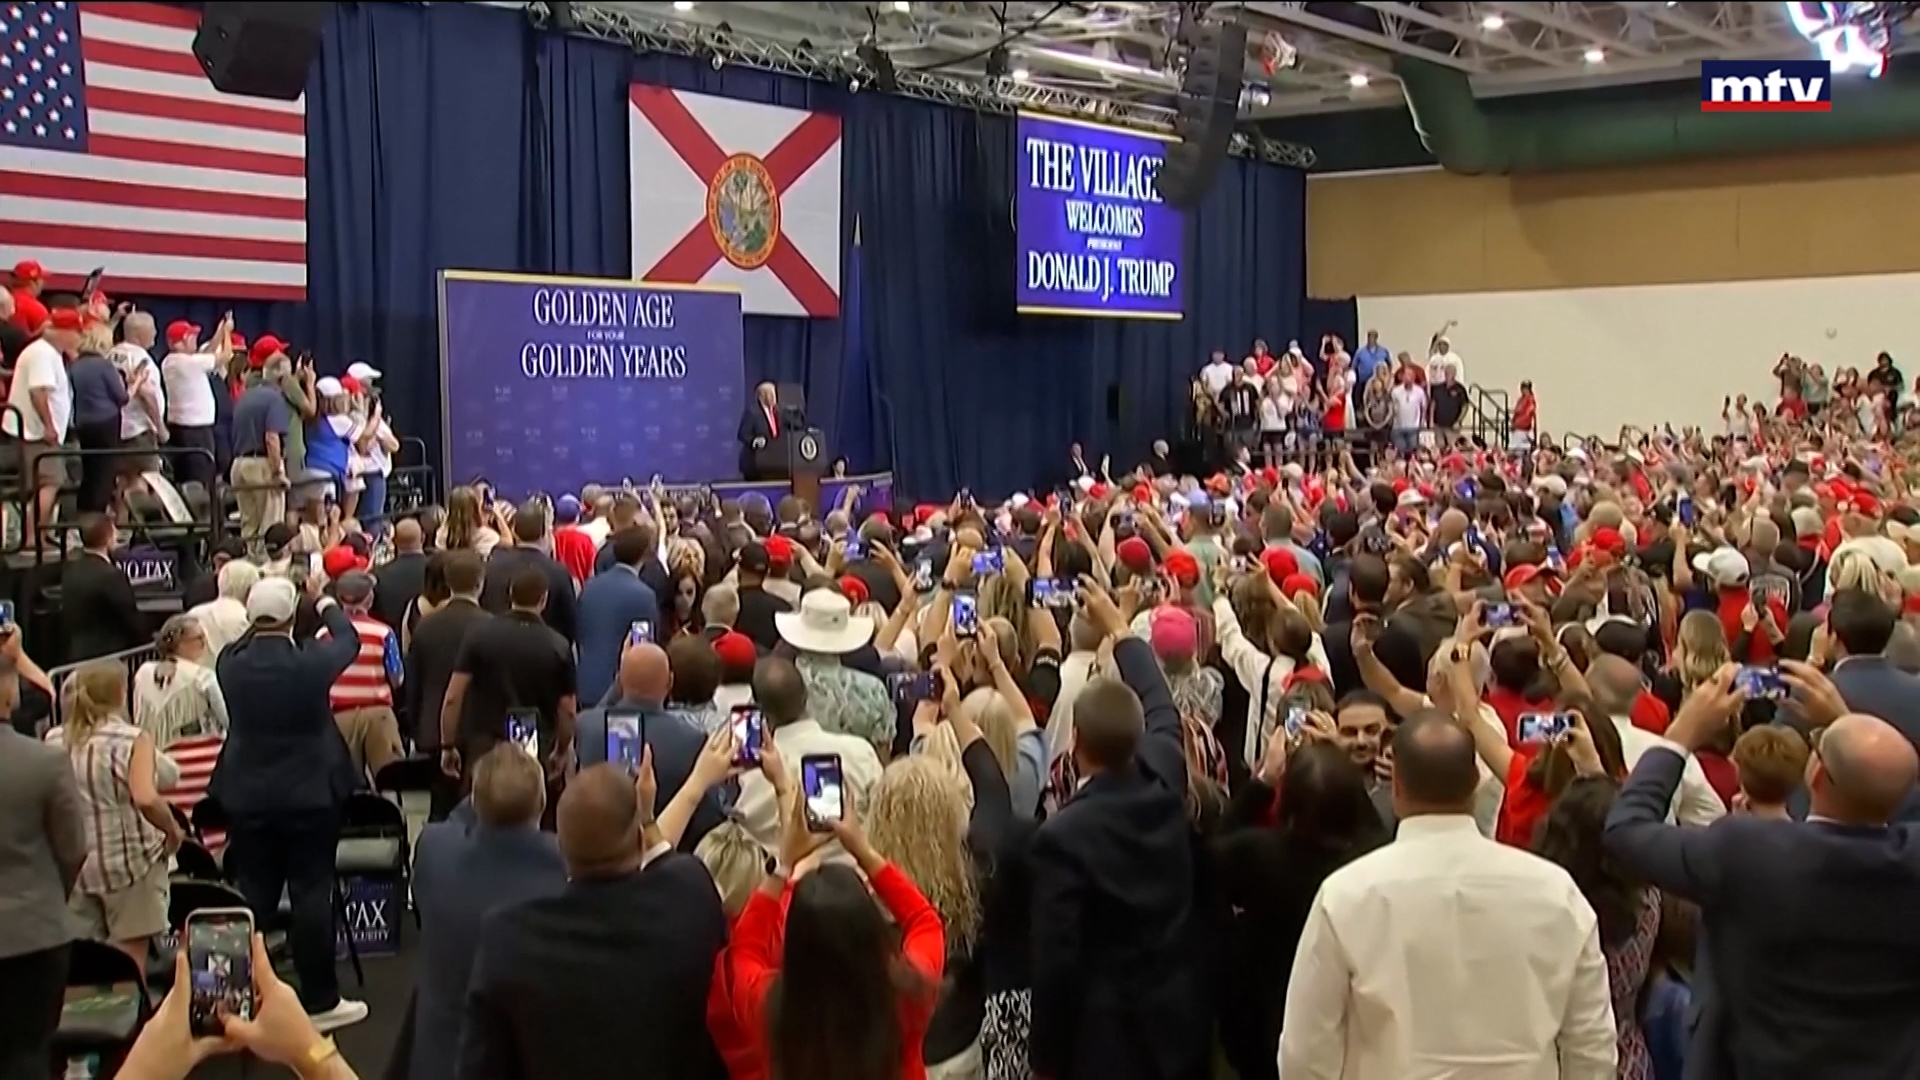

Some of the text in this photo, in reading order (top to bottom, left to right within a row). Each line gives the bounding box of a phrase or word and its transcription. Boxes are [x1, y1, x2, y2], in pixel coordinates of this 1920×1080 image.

[1026, 137, 1164, 204] THE VILLAGE
[1065, 199, 1144, 238] WELCOMES
[1027, 250, 1176, 302] DONALD J. TRUMP
[533, 288, 675, 328] GOLDEN AGE
[521, 342, 687, 379] GOLDEN YEARS
[142, 560, 173, 580] TAX
